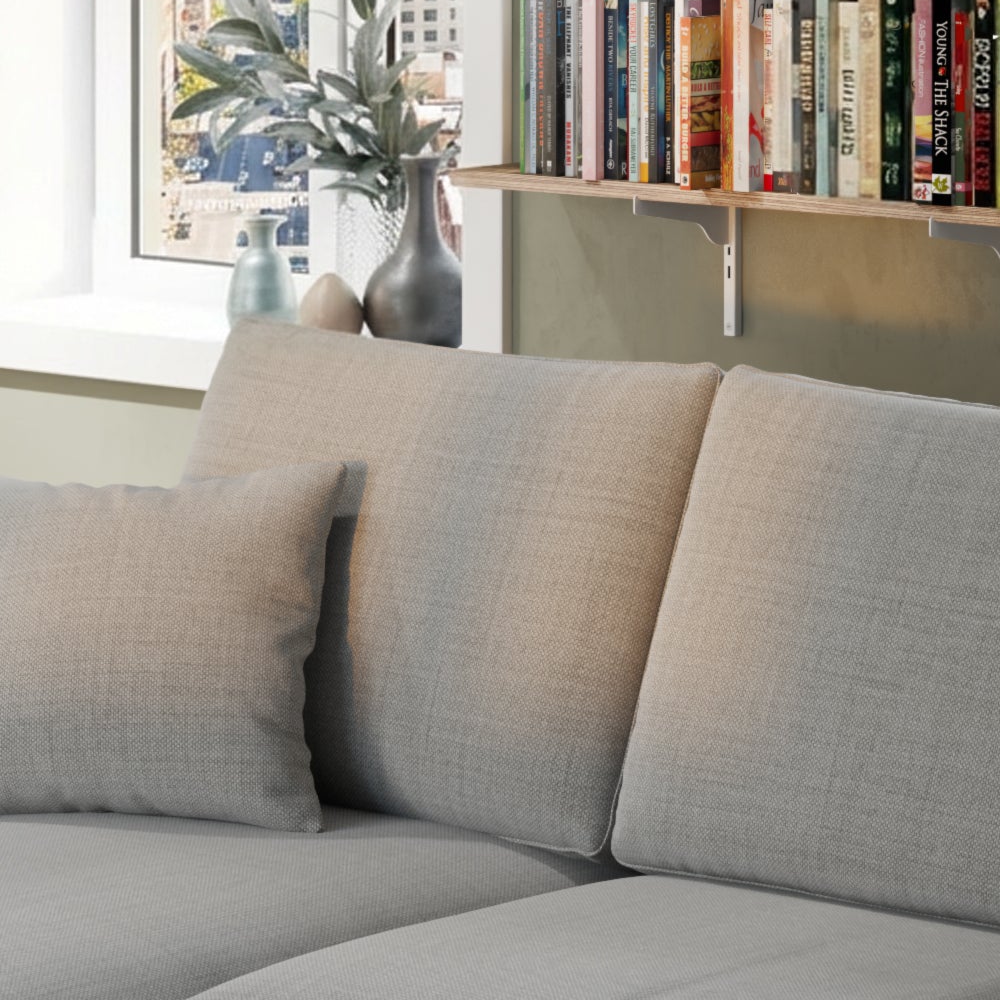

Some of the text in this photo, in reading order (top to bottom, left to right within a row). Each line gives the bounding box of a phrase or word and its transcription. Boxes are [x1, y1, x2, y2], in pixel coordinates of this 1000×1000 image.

[936, 21, 948, 156] YOUNG THE SHACK
